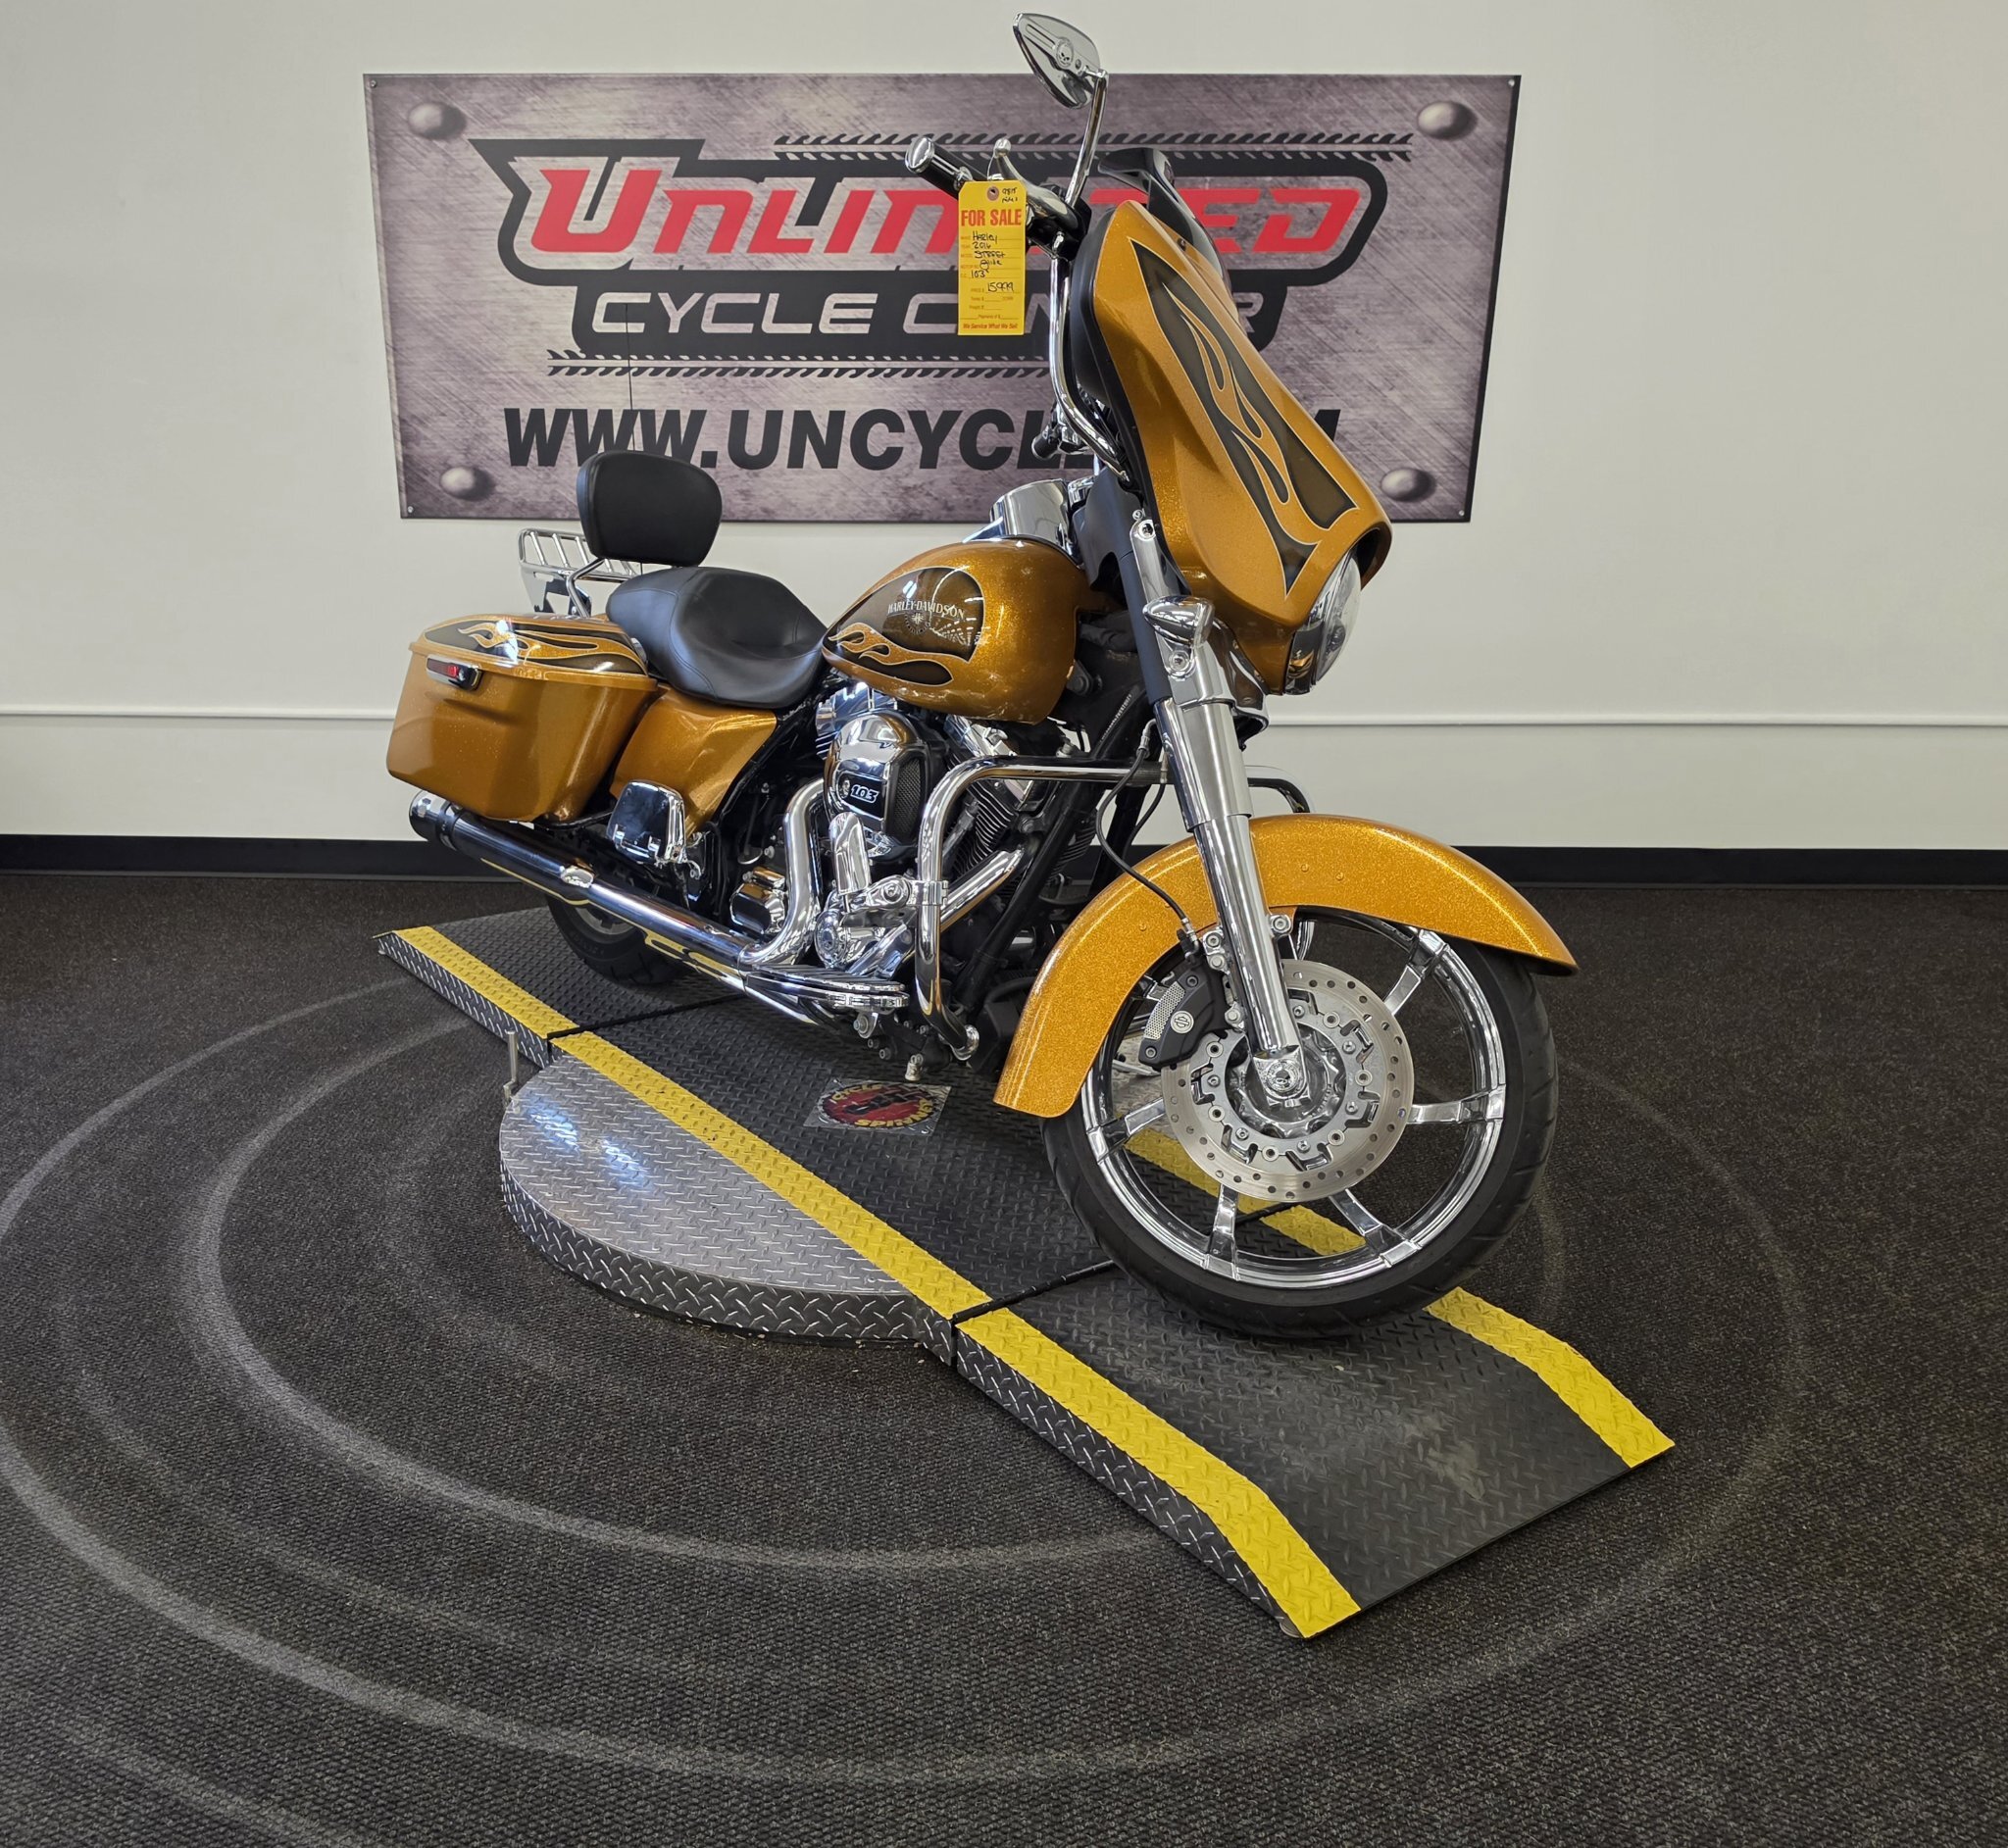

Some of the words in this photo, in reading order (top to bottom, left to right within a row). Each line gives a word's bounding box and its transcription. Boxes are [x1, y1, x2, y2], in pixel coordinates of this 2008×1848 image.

[530, 169, 1361, 254] UNLIMED
[961, 209, 985, 226] FOR
[990, 208, 1022, 225] SALE
[592, 292, 878, 334] CYCLE
[887, 600, 966, 620] HARLEY-DAVIDSON
[850, 784, 879, 803] 103
